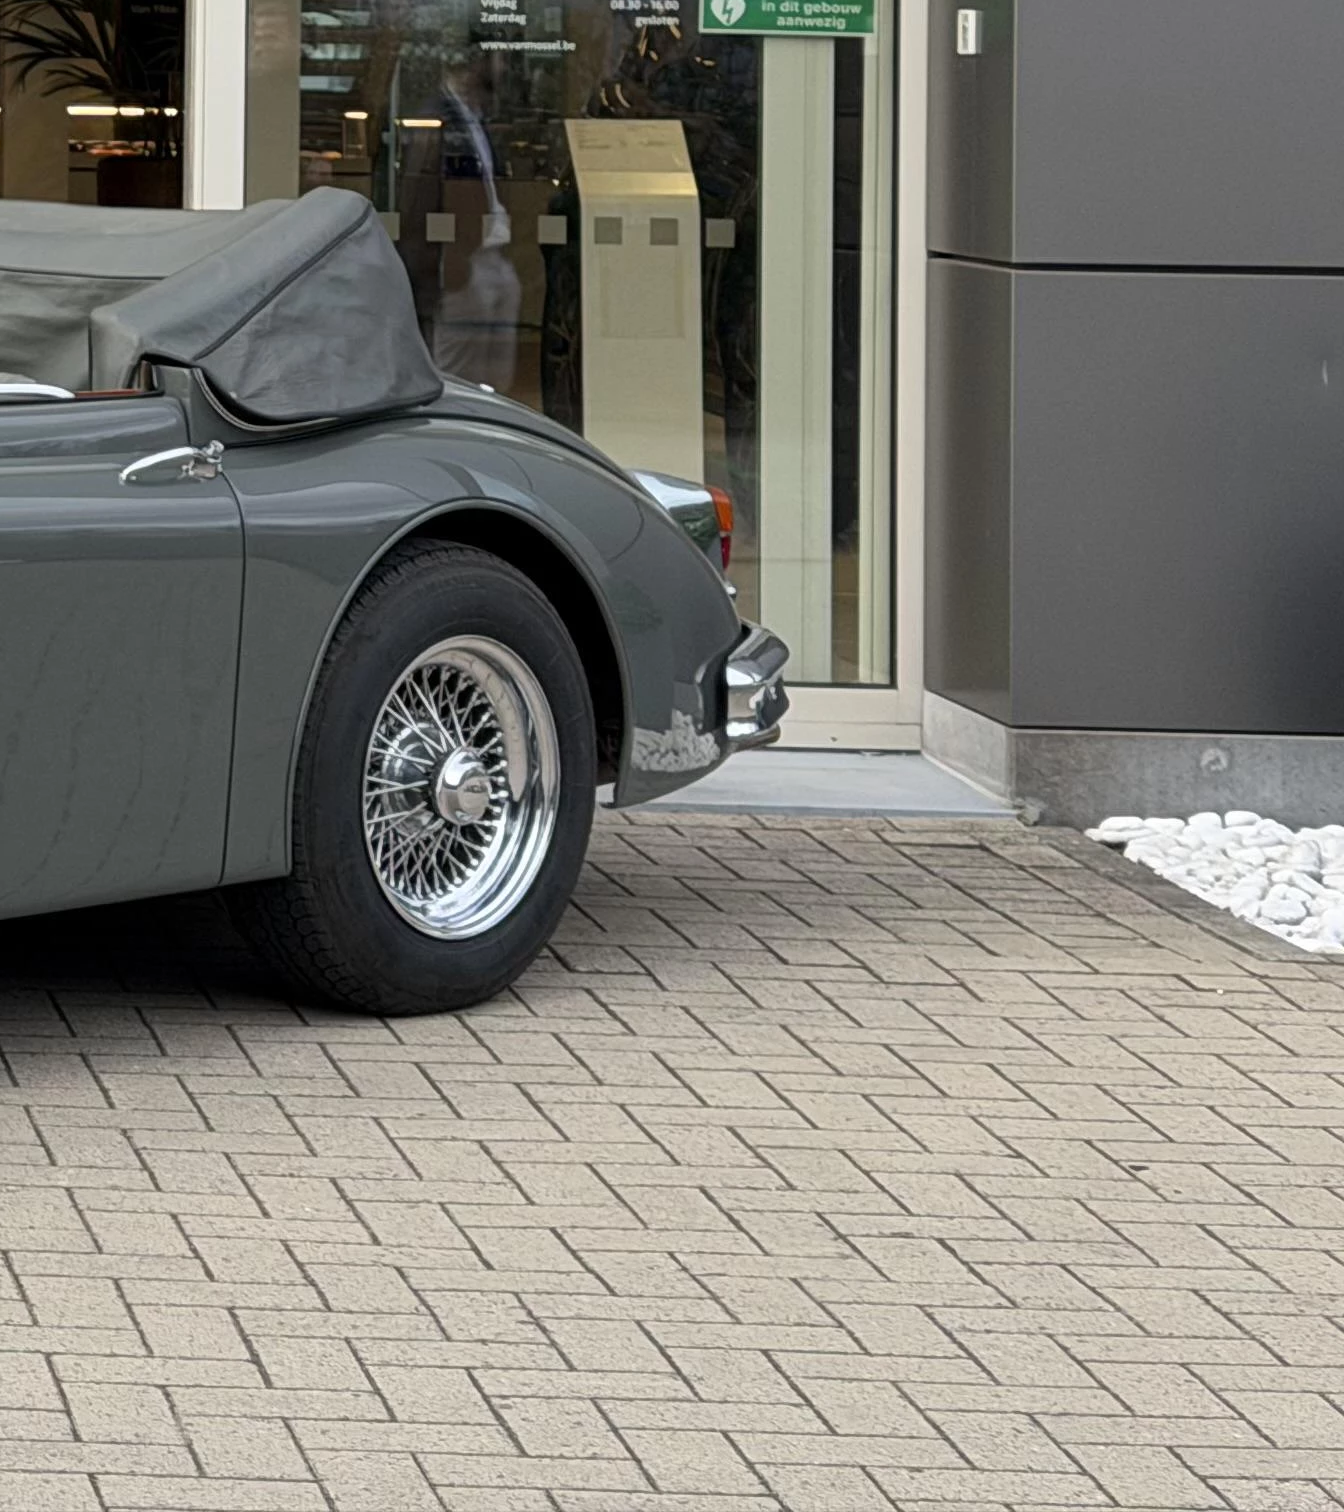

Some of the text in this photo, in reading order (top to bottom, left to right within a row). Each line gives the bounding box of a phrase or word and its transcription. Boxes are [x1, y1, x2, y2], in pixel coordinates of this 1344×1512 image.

[762, 0, 862, 16] in dit gebouw
[480, 12, 527, 25] Zaterdag
[776, 16, 846, 30] aanwezig
